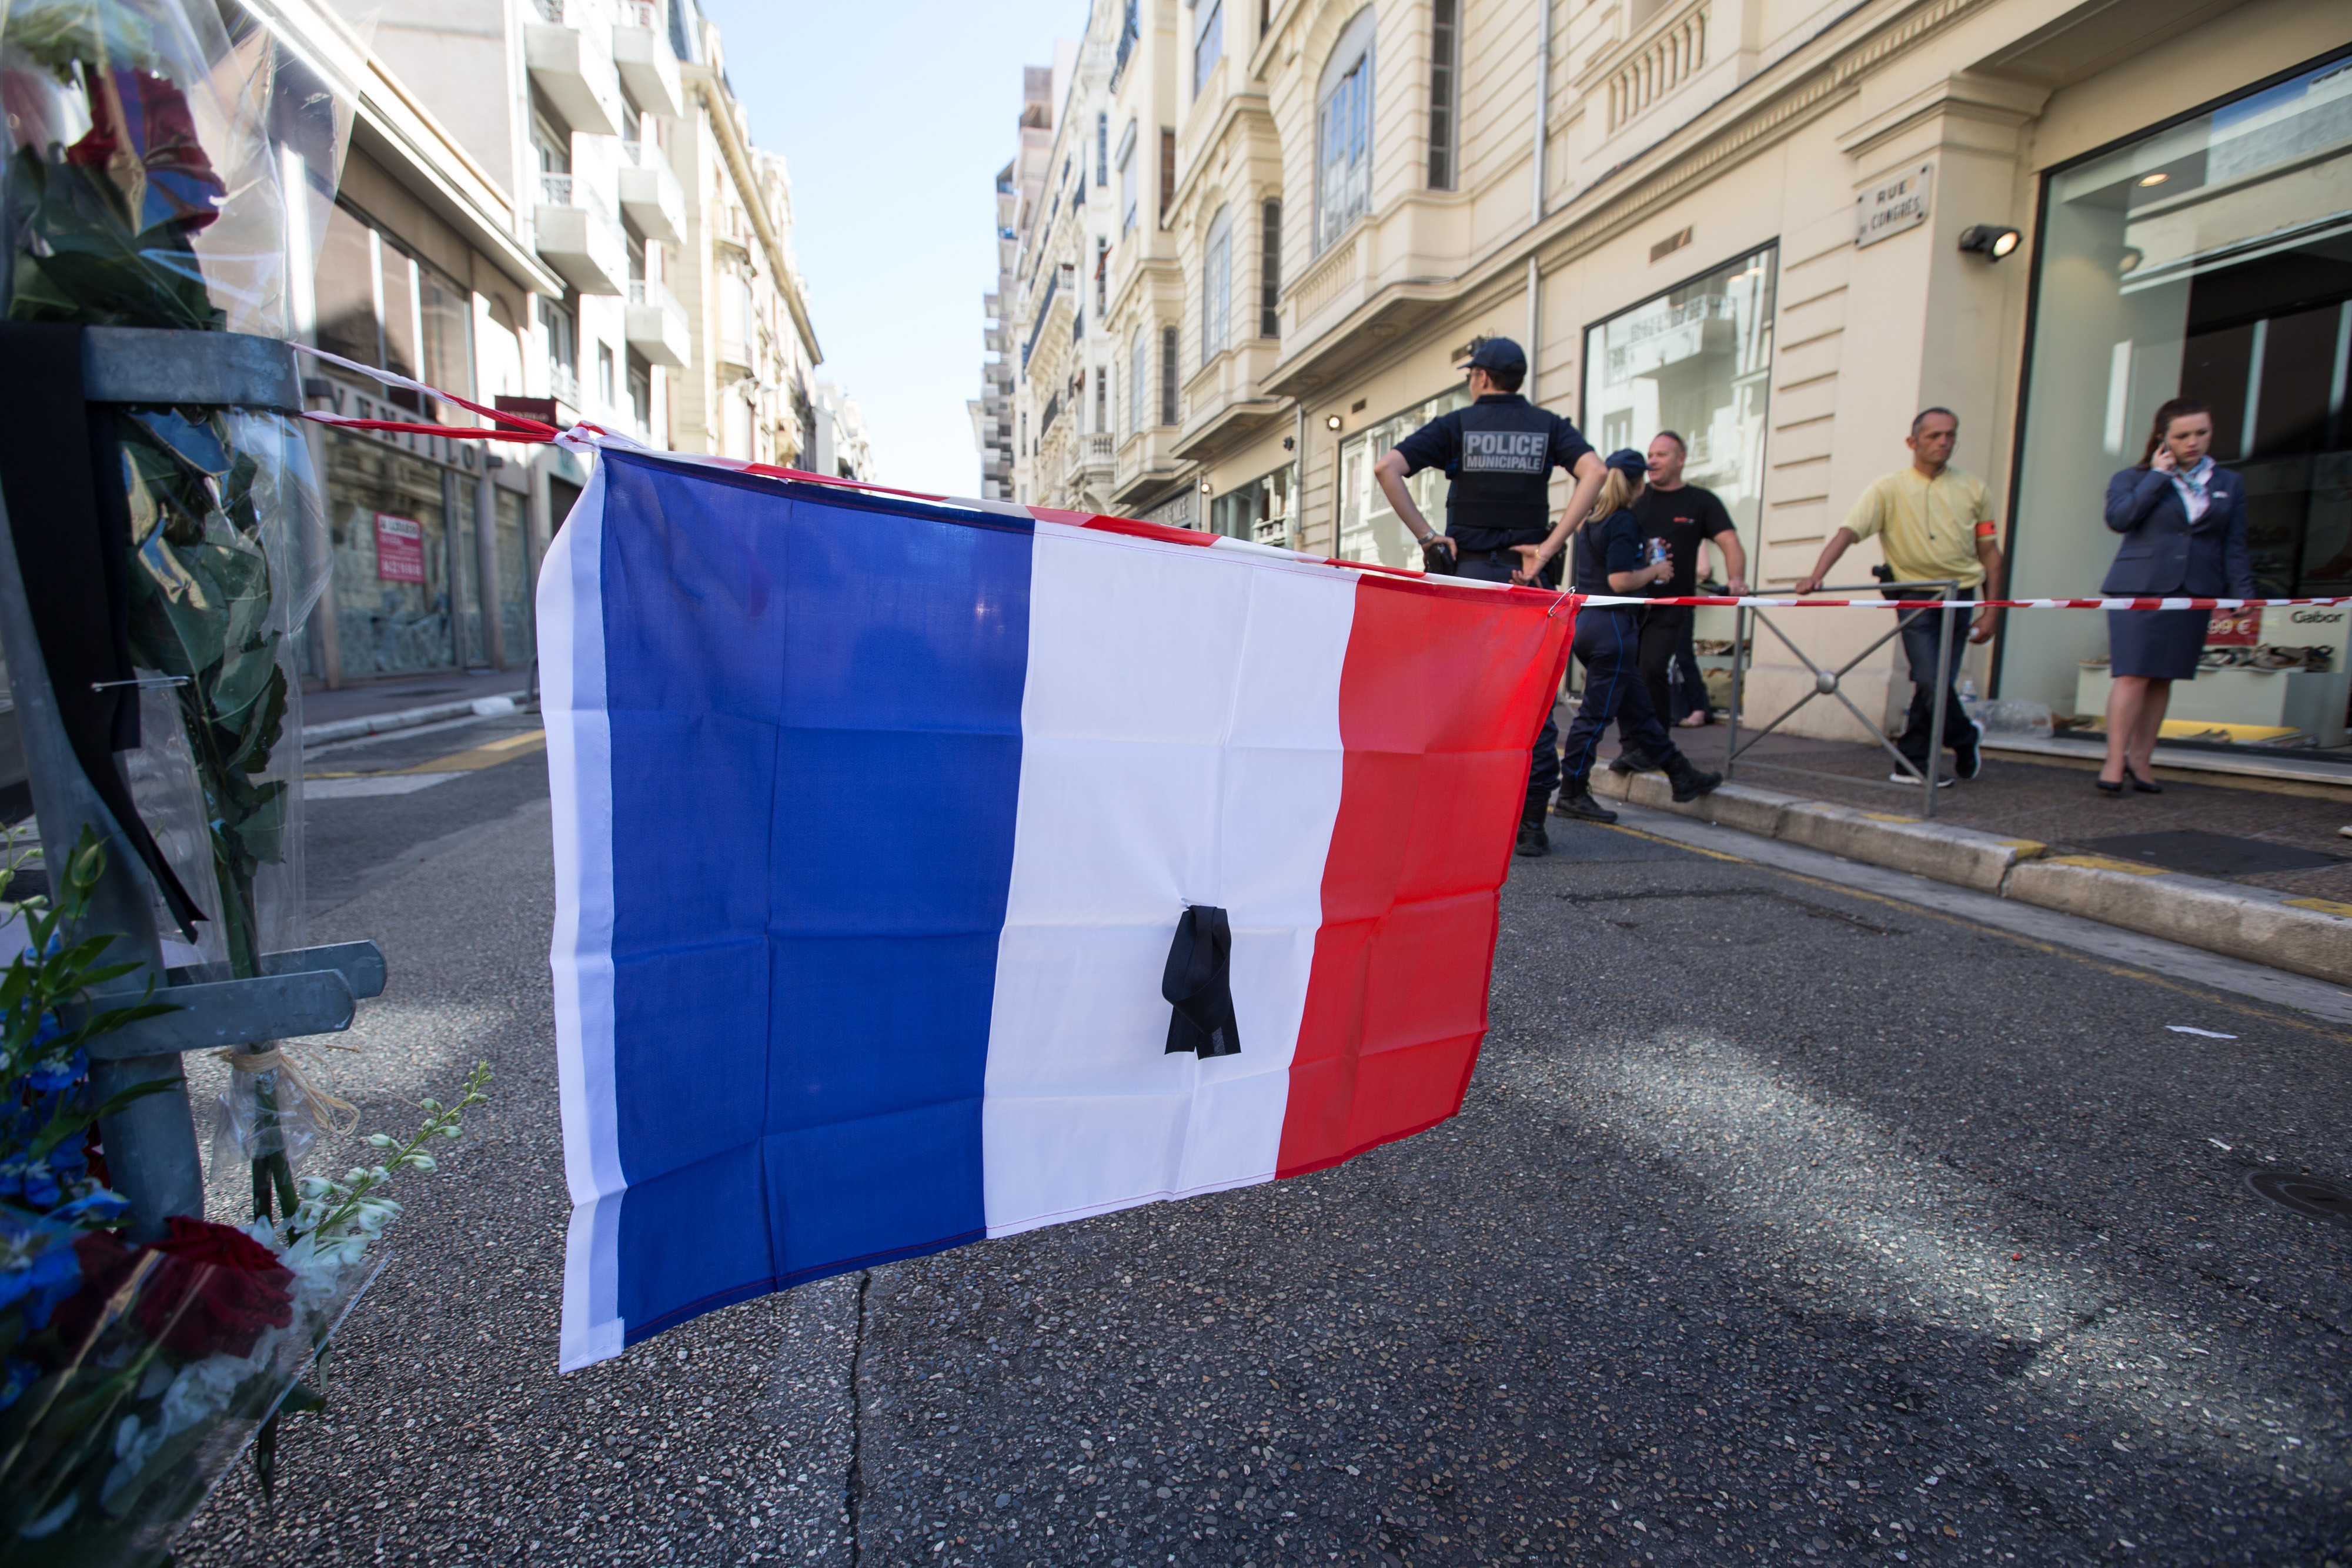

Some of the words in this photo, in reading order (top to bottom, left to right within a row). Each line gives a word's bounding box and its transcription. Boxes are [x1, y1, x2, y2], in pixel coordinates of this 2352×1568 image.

[1876, 179, 1908, 205] RUE
[1468, 434, 1544, 456] POLICE
[1466, 455, 1542, 470] MUNICIPALE
[2290, 610, 2344, 624] Gabor
[2207, 618, 2234, 635] 99
[2236, 618, 2253, 635] €
